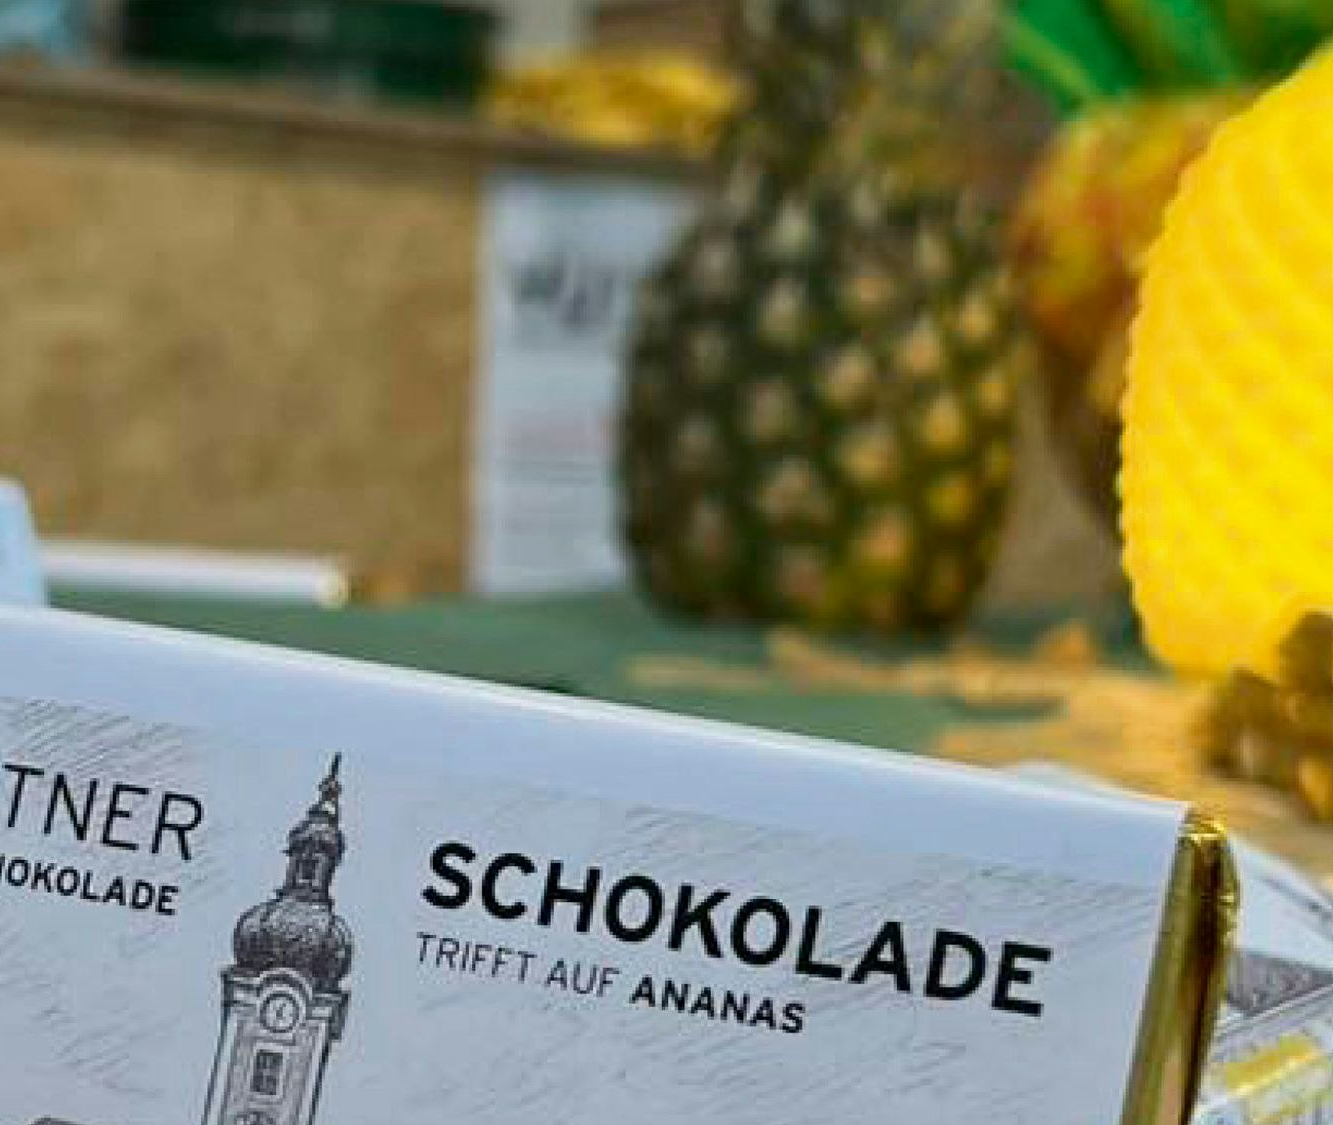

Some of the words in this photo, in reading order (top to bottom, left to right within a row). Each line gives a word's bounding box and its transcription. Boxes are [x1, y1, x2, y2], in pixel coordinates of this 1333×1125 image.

[417, 932, 536, 983] TRIFFT
[545, 959, 620, 998] AUF
[630, 976, 808, 1034] ANANAS
[422, 841, 1053, 1017] SCHOKOLADE
